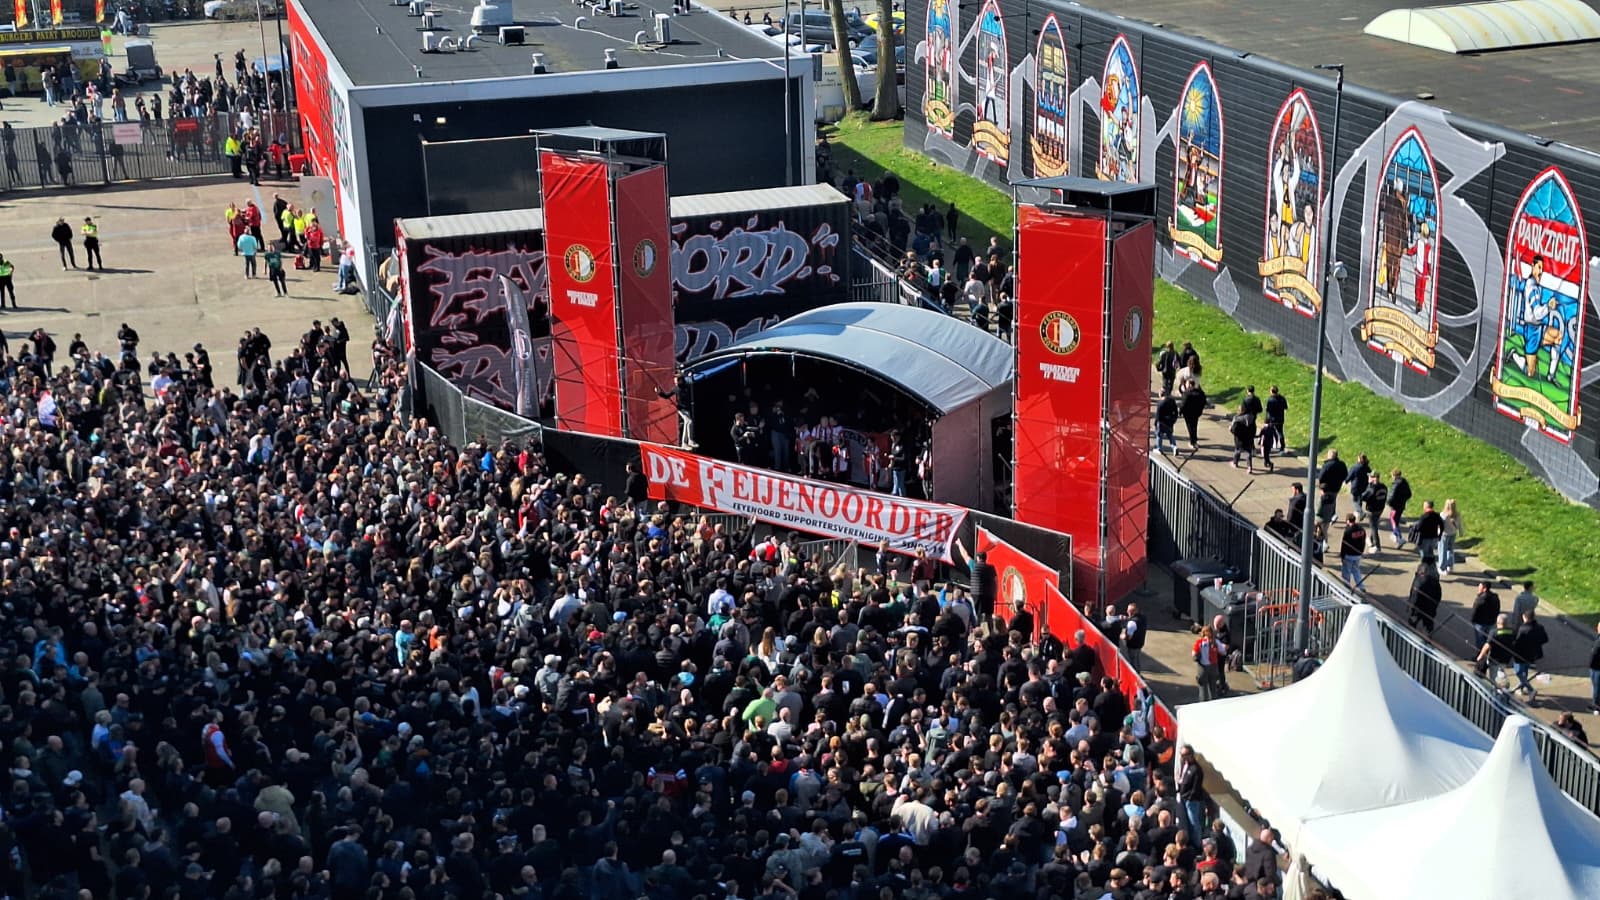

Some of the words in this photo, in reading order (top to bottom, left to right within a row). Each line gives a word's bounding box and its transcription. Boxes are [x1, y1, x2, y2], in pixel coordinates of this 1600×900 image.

[1518, 218, 1579, 265] PARKZICHT
[647, 451, 689, 488] DE
[698, 459, 954, 543] FEIJENOORDER
[732, 502, 781, 519] FEYENOORD
